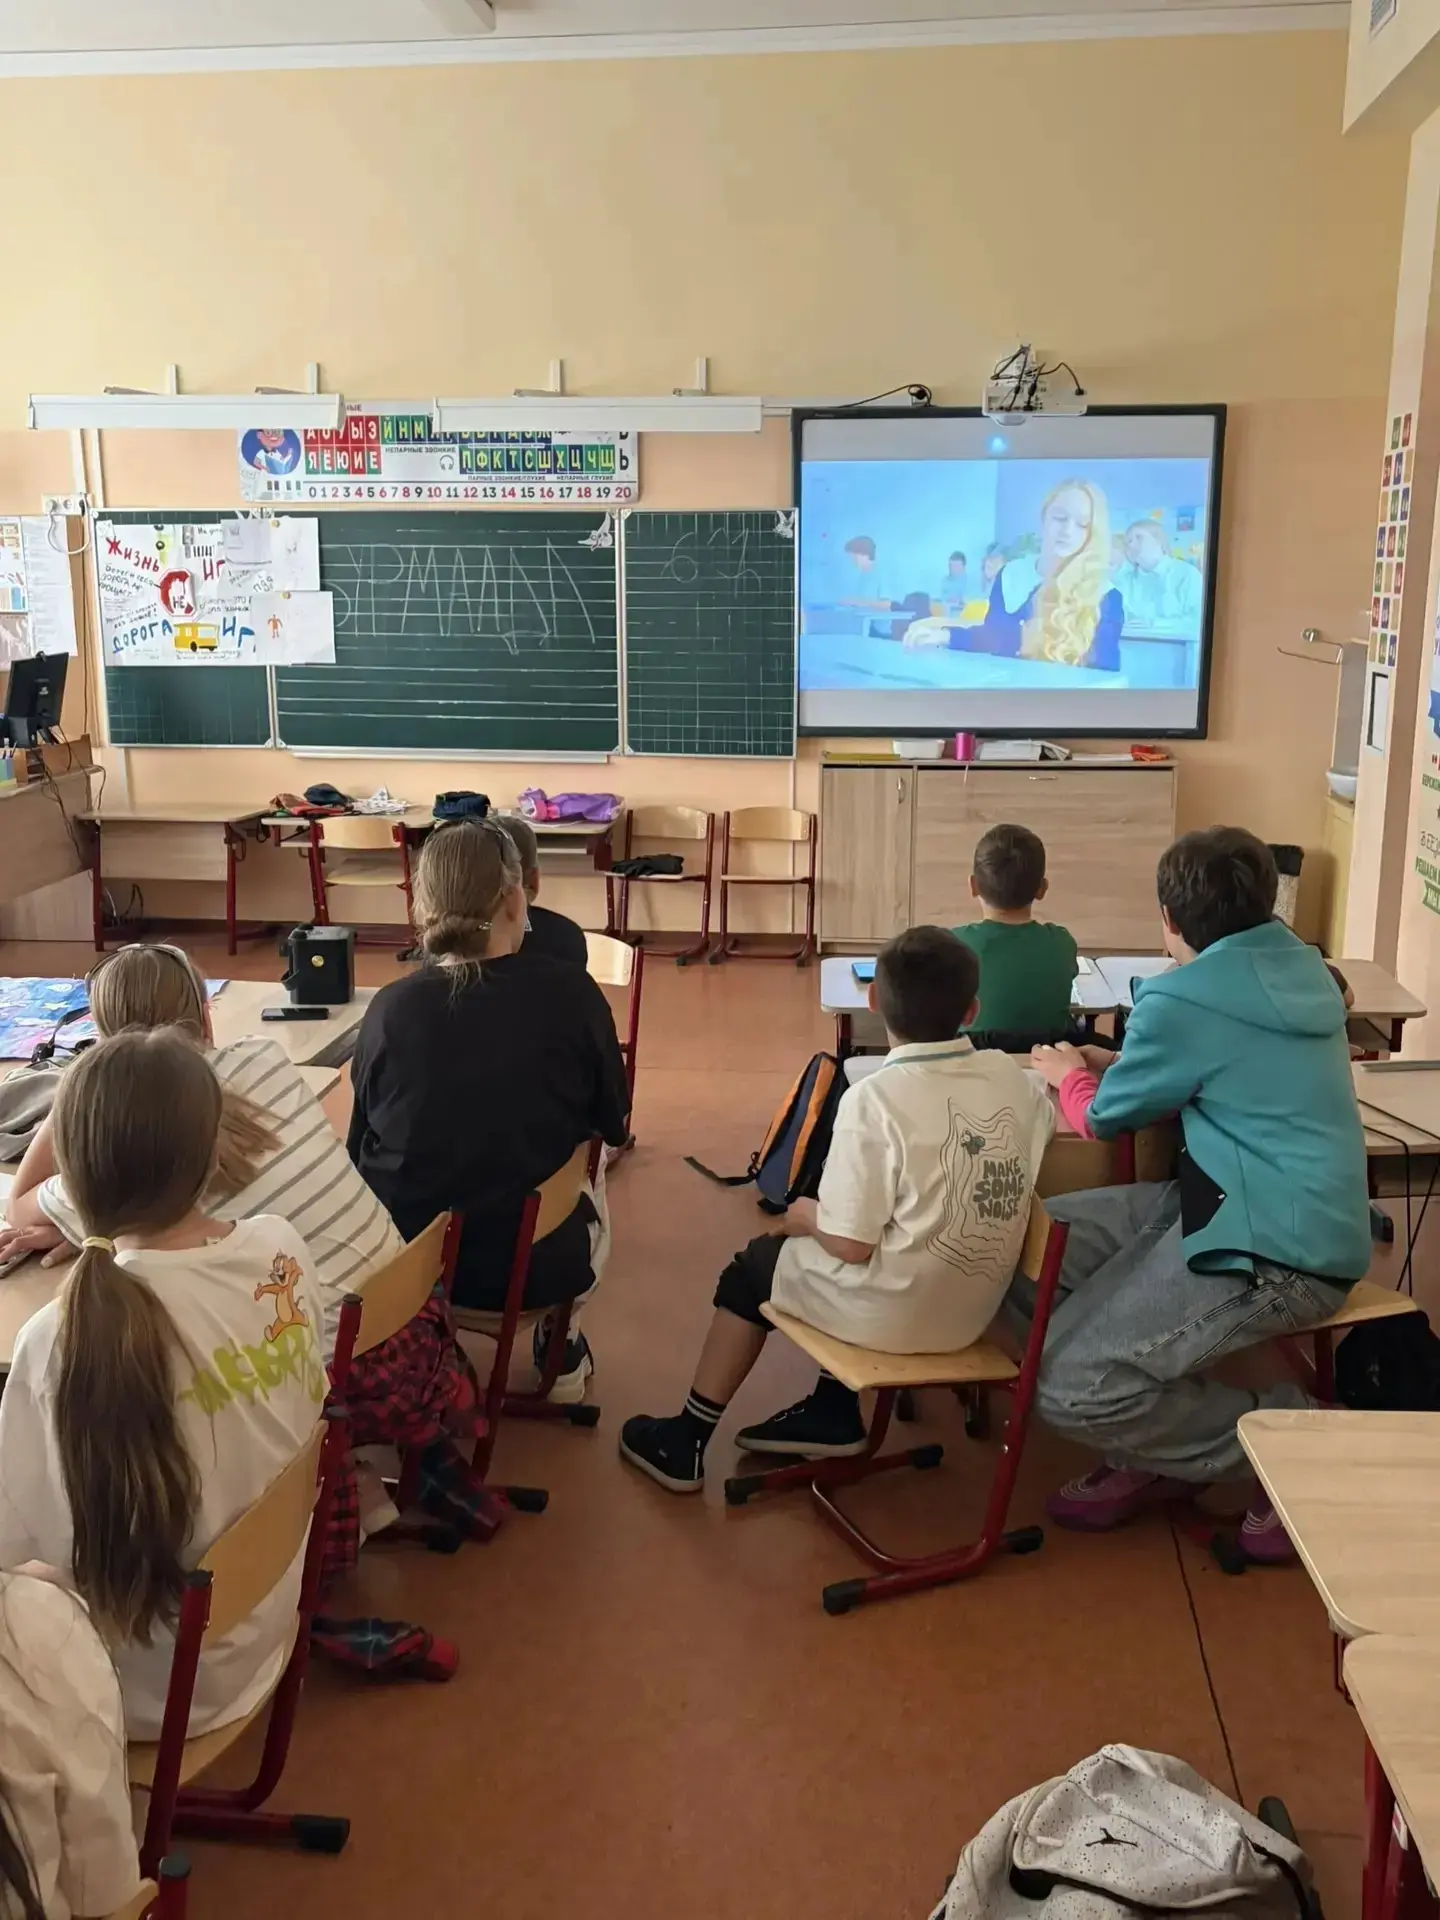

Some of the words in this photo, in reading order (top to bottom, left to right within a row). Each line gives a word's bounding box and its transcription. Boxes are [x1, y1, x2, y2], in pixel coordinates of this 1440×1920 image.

[385, 446, 423, 454] НЕПАРНЫЕ
[424, 446, 457, 454] ЗВОНКИЕ
[309, 486, 317, 498] 0
[321, 486, 327, 498] 1
[331, 486, 339, 498] 2
[343, 486, 351, 498] 3
[354, 486, 363, 498] 4
[367, 486, 375, 498] 5
[379, 486, 387, 498] 6
[391, 486, 398, 498] 7
[402, 486, 411, 498] 8
[414, 486, 423, 498] 9
[427, 486, 442, 498] 10
[446, 486, 460, 498] 11
[463, 486, 478, 498] 12
[482, 486, 497, 498] 13
[501, 486, 517, 498] 14
[520, 486, 536, 498] 15
[539, 486, 555, 498] 16
[558, 486, 573, 498] 17
[577, 486, 592, 498] 18
[595, 486, 611, 498] 19
[615, 486, 632, 498] 20
[106, 533, 161, 573] ЖИЗНЬ
[112, 618, 174, 656] ДОРОГА
[983, 1156, 1021, 1179] MAKE
[973, 1173, 1025, 1203] SOME
[977, 1197, 1020, 1222] NOISE
